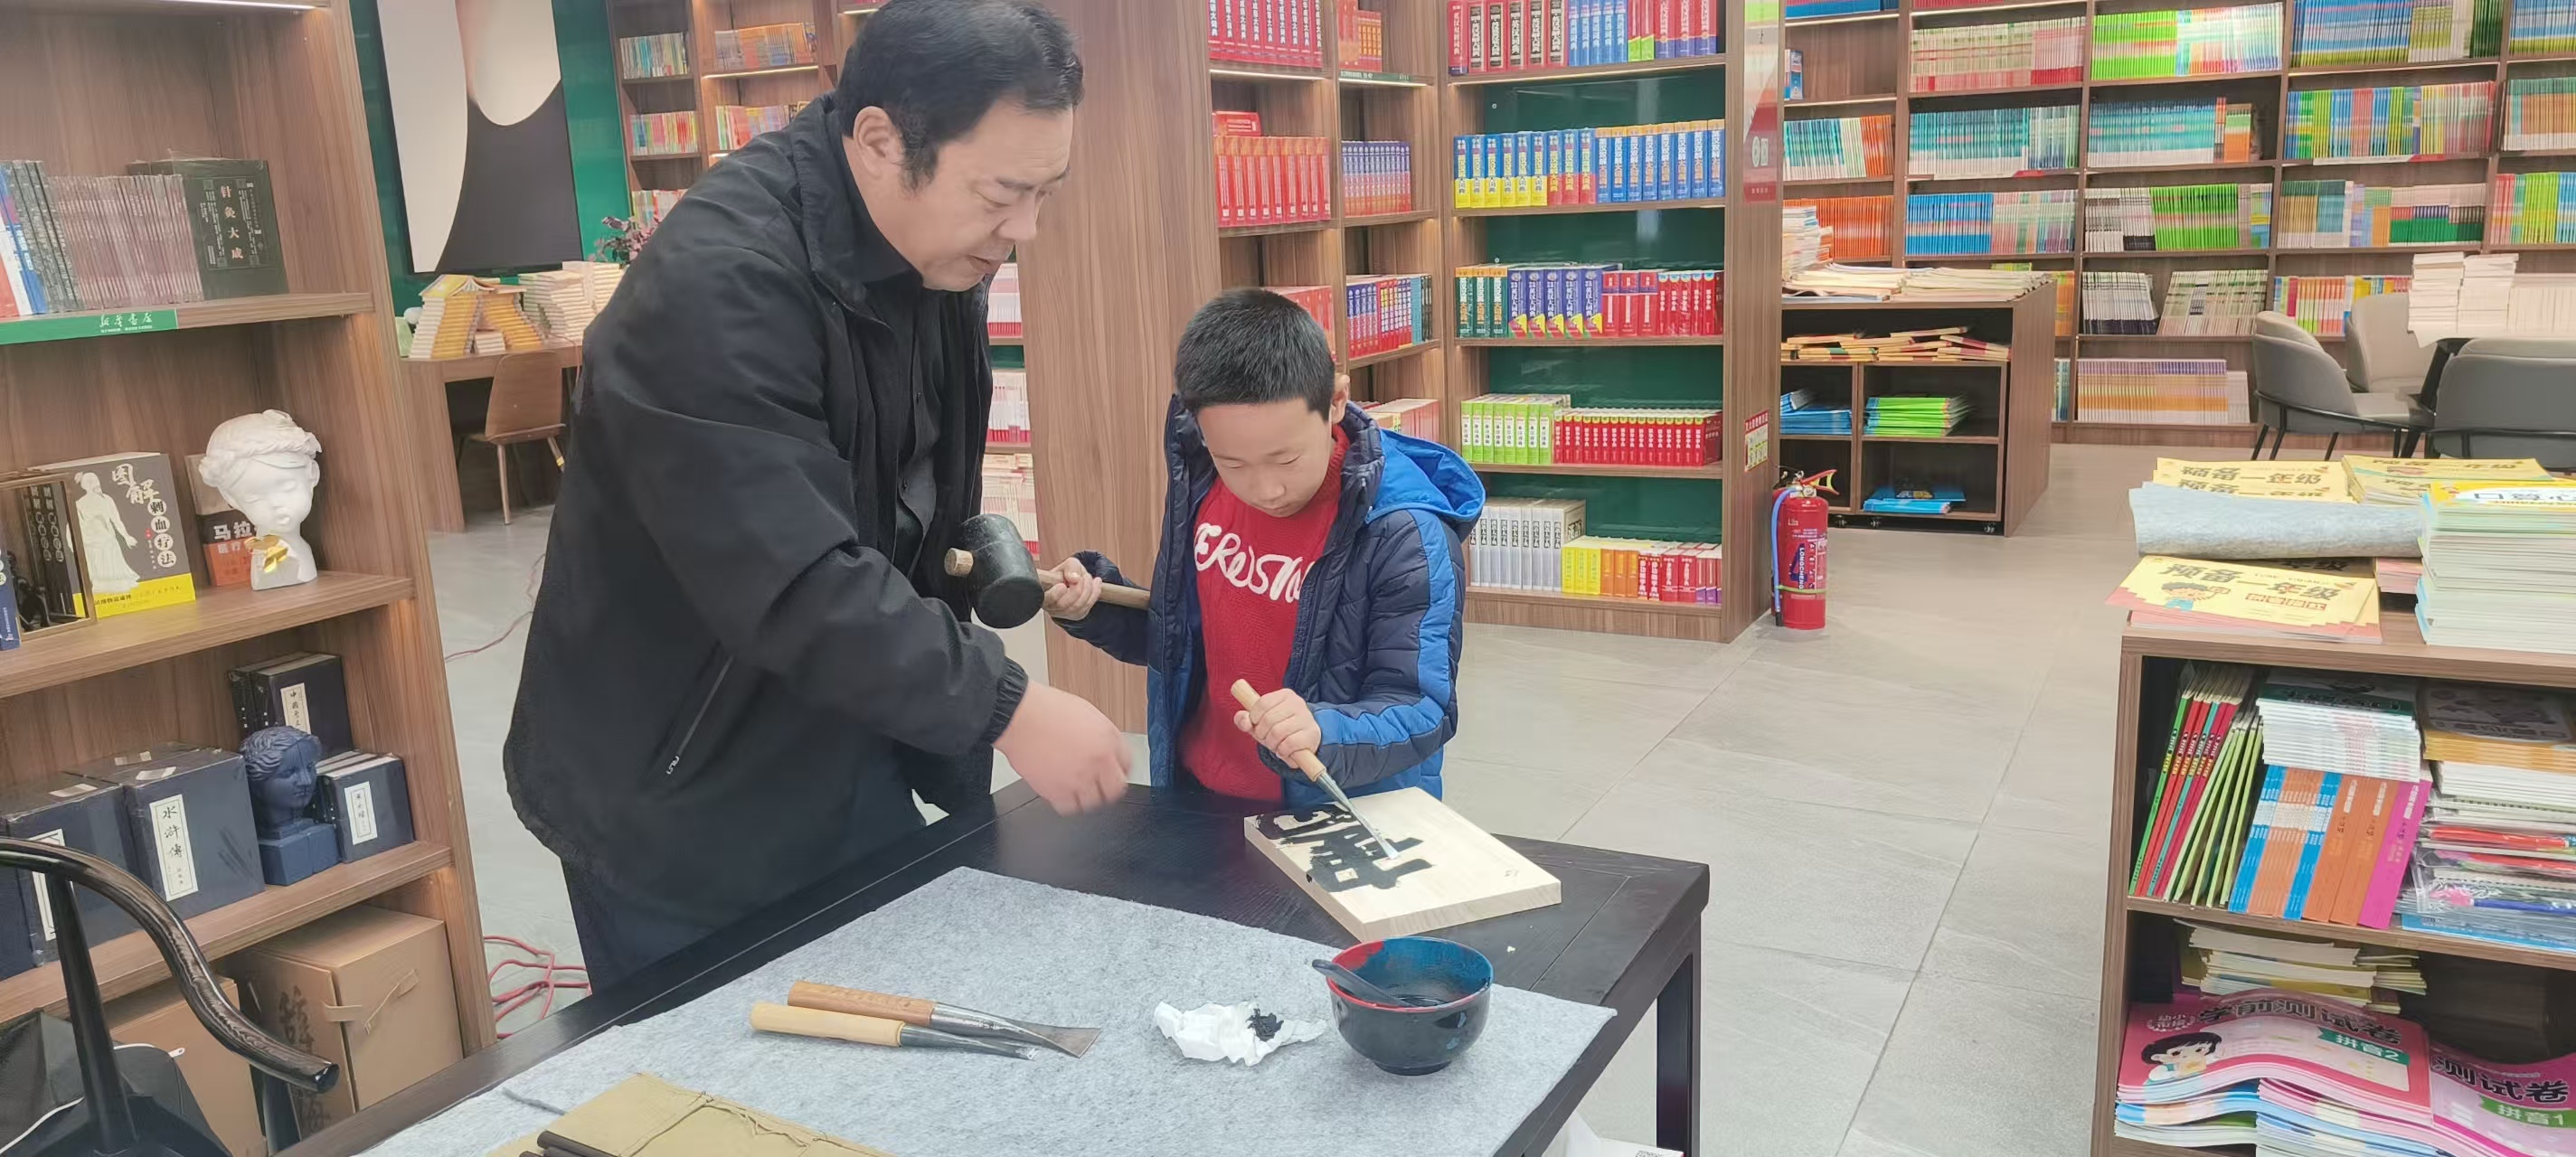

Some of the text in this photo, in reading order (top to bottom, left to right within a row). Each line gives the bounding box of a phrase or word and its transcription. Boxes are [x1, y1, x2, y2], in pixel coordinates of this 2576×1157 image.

[221, 185, 243, 259] 针灸大成
[2181, 466, 2322, 484] 预备一年级
[149, 500, 175, 566] 刺血疗法
[213, 521, 257, 541] 马拉
[2157, 563, 2341, 600] 预备一年级
[2198, 999, 2401, 1044] 学前测试卷
[2336, 1034, 2399, 1060] 拼音2
[2430, 1055, 2569, 1104] 测试卷
[2497, 1105, 2563, 1125] 拼音1
